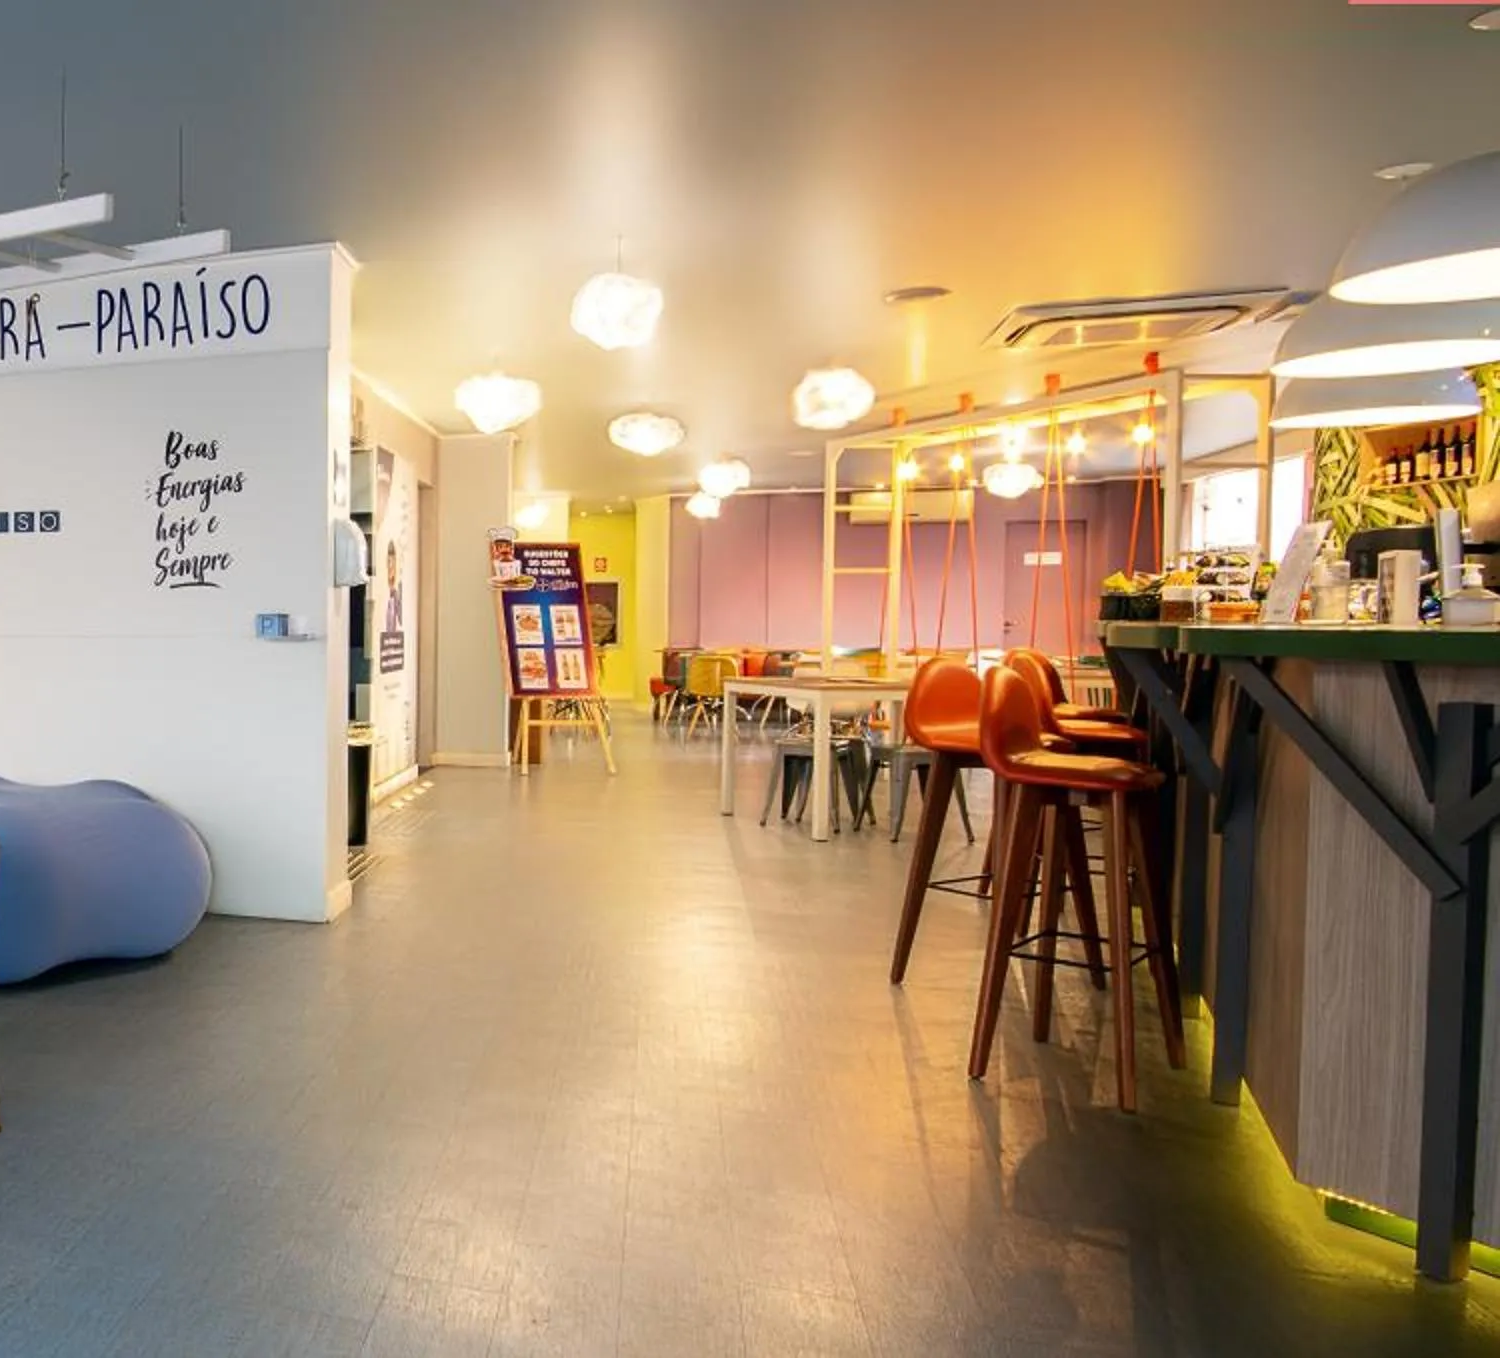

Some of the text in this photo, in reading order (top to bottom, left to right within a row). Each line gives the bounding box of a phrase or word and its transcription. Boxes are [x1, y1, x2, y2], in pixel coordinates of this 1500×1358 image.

[164, 430, 219, 469] Boas
[155, 471, 246, 513] Energias
[155, 512, 219, 555] hoje e
[154, 547, 232, 586] Sempre
